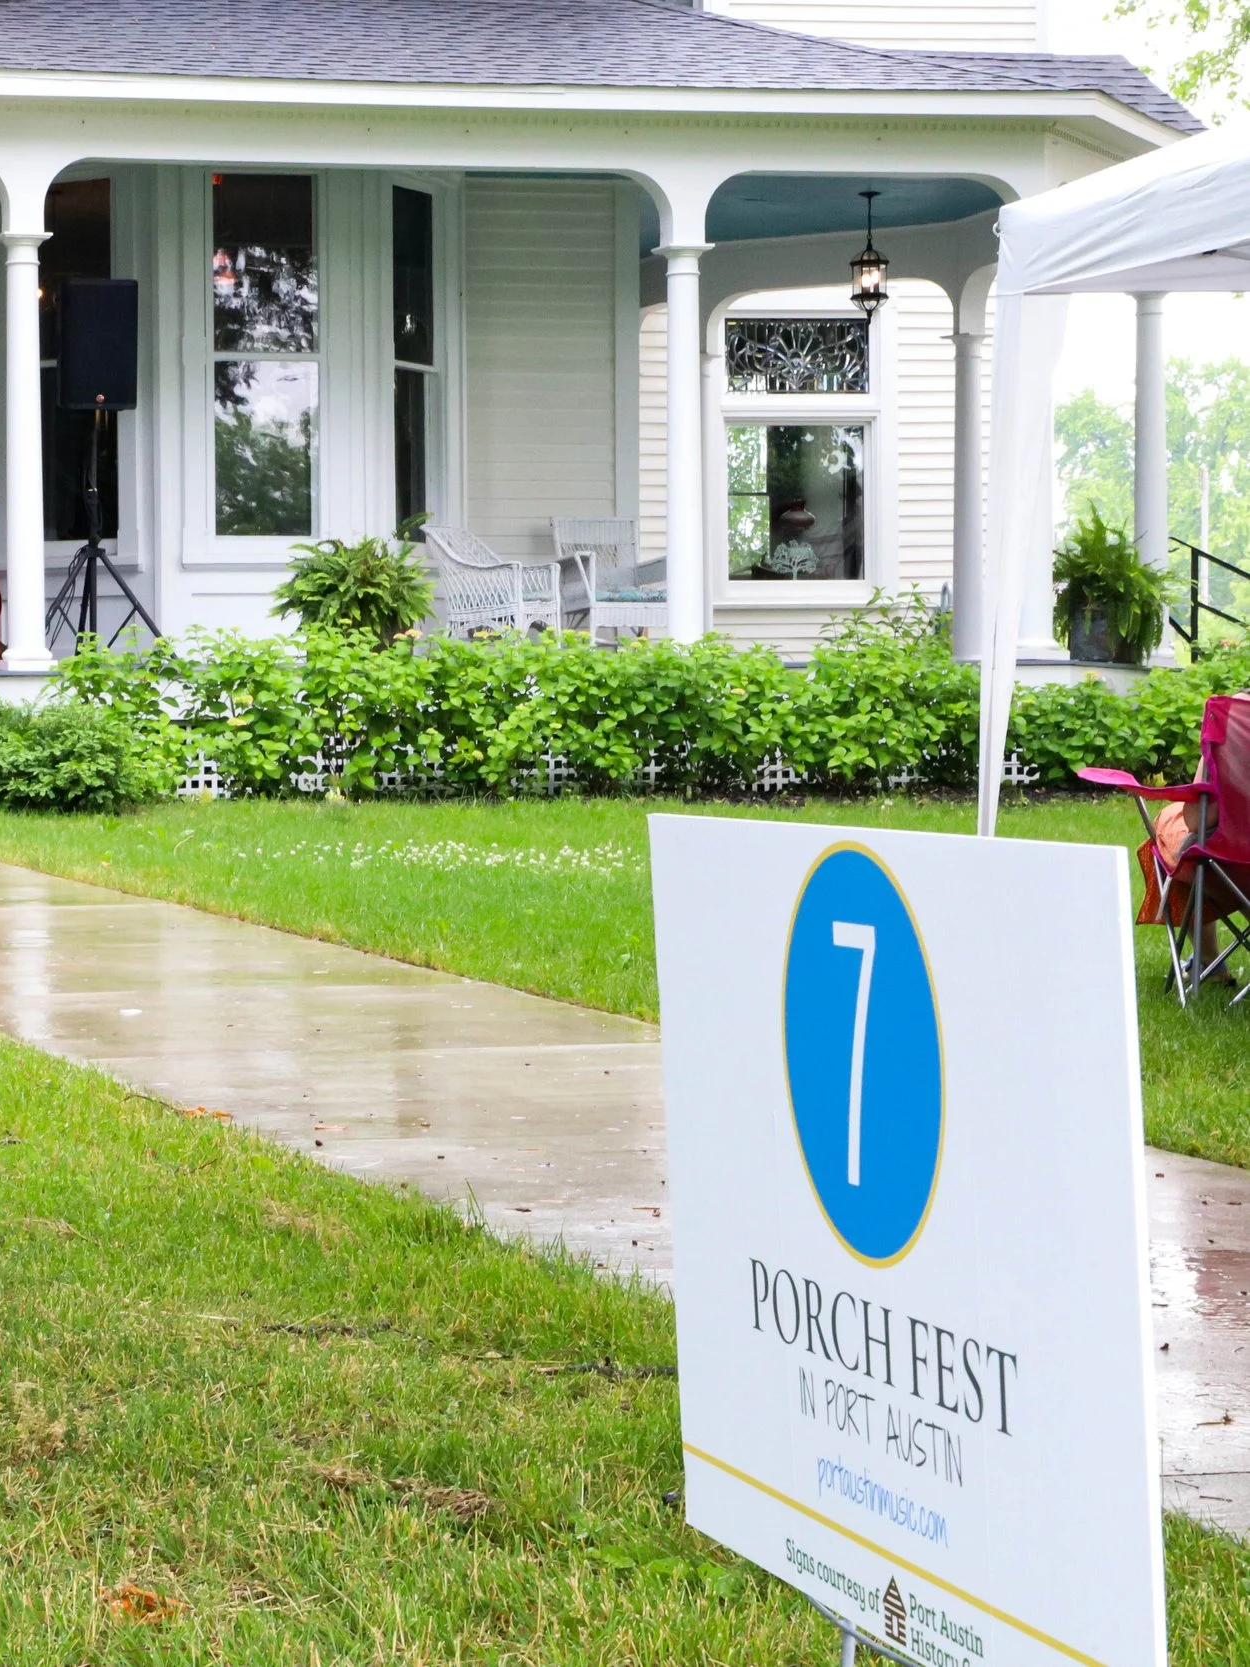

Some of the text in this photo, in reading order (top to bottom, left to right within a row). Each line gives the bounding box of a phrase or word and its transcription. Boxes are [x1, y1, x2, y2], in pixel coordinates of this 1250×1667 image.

[832, 920, 876, 1187] 7
[748, 1257, 1018, 1437] PORCH FEST
[799, 1366, 963, 1488] IN PORT AUSTIN
[817, 1455, 949, 1549] portaustinmusic.com
[785, 1537, 880, 1614] Signs courtesy of
[909, 1592, 984, 1658] Port Austin
